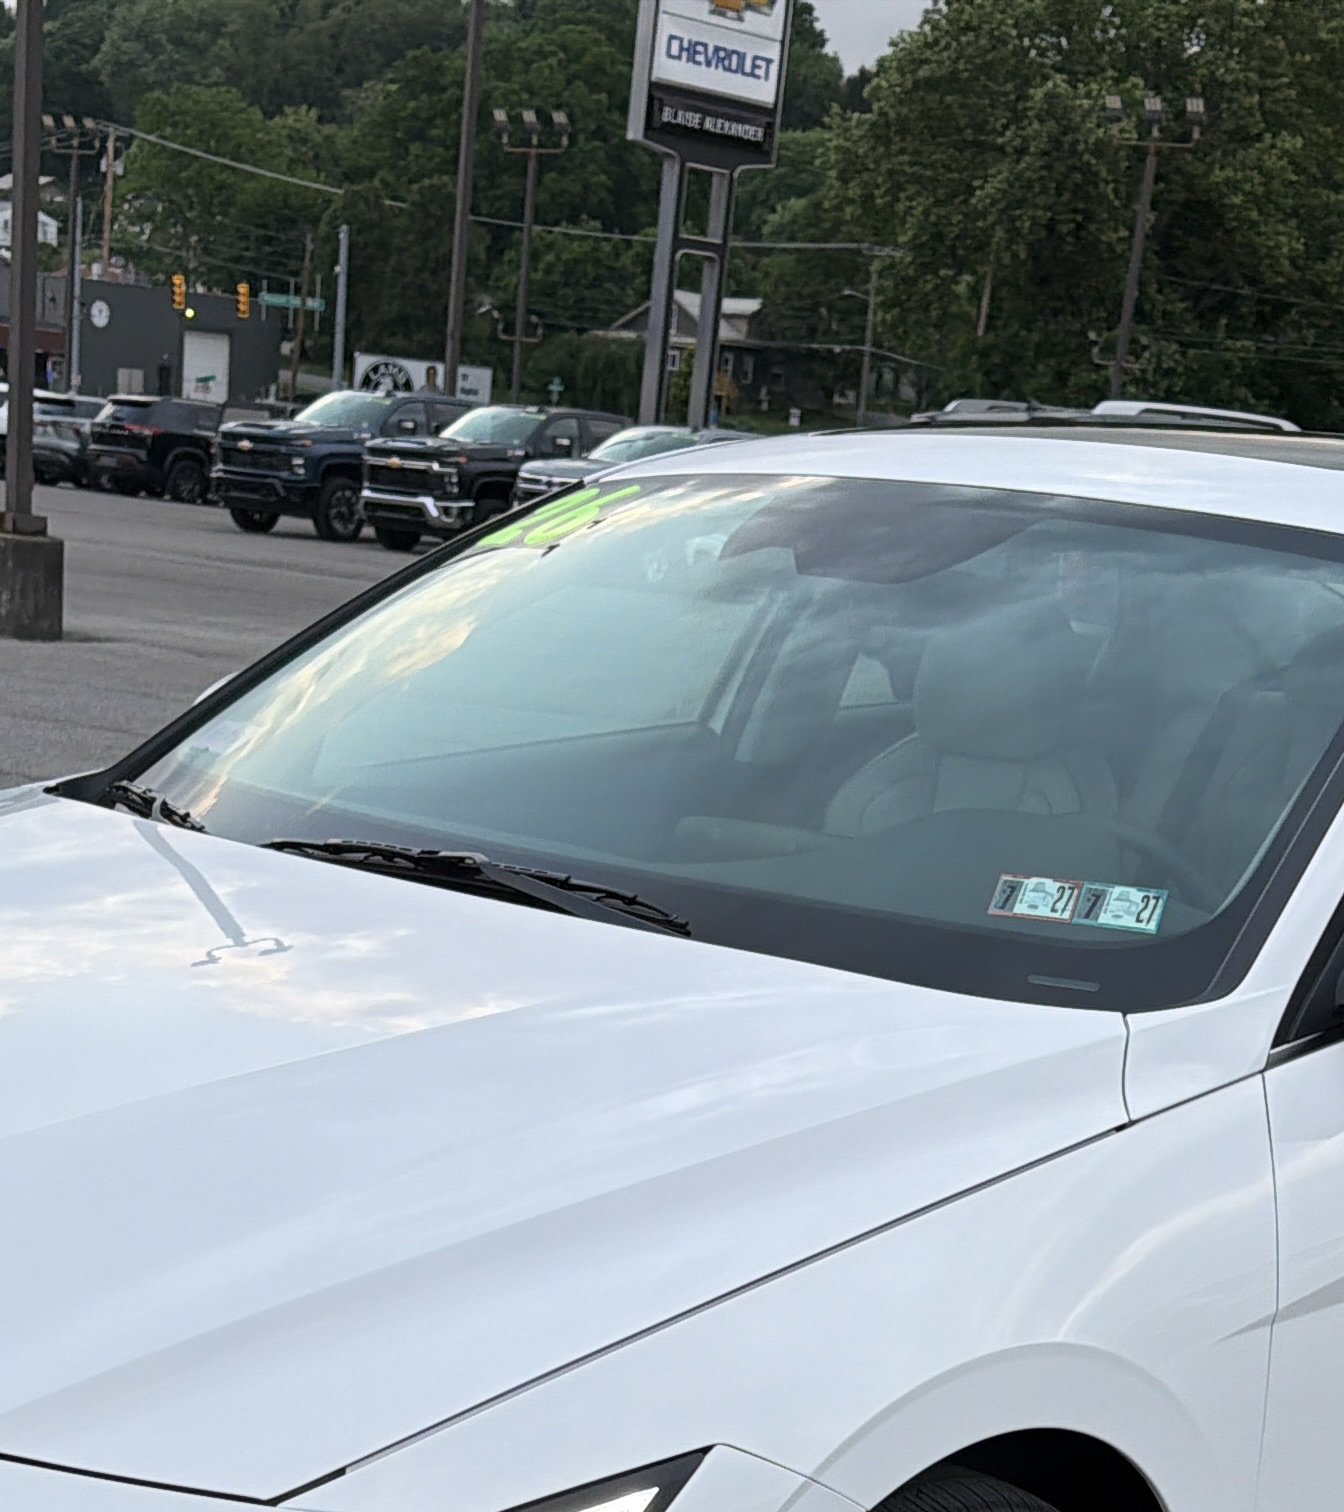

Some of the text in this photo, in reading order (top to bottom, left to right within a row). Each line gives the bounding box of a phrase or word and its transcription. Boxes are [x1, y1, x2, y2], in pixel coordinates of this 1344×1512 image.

[665, 34, 775, 82] CHEVROLET
[1050, 885, 1076, 917] 27
[1083, 892, 1102, 919] 7
[1135, 894, 1161, 927] 27
